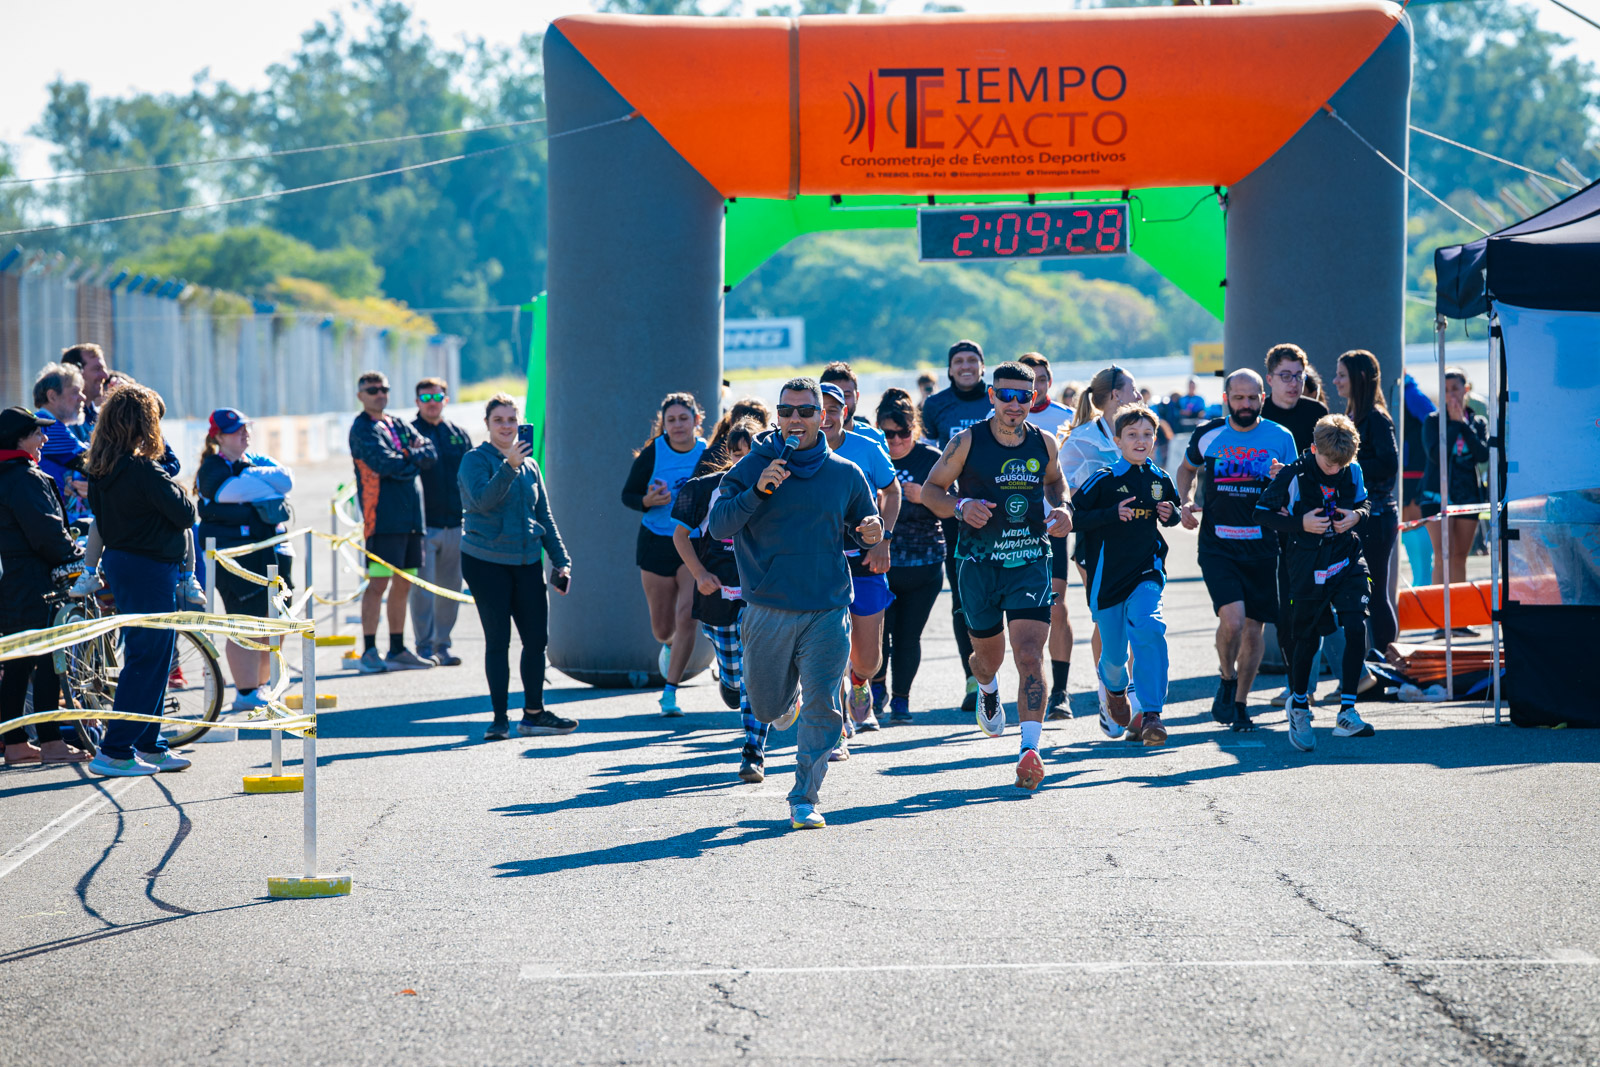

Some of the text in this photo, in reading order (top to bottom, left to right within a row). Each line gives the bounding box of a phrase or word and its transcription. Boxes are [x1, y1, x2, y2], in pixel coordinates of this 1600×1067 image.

[840, 151, 1126, 168] Cronometraje de Eventos Deportivos
[952, 208, 1122, 257] 2:09:28
[1029, 460, 1038, 472] 3
[994, 473, 1040, 484] EGUSQUIZA
[1002, 525, 1031, 538] MEDIA
[993, 537, 1040, 551] MARATÓN
[990, 546, 1043, 561] NOCTURNA
